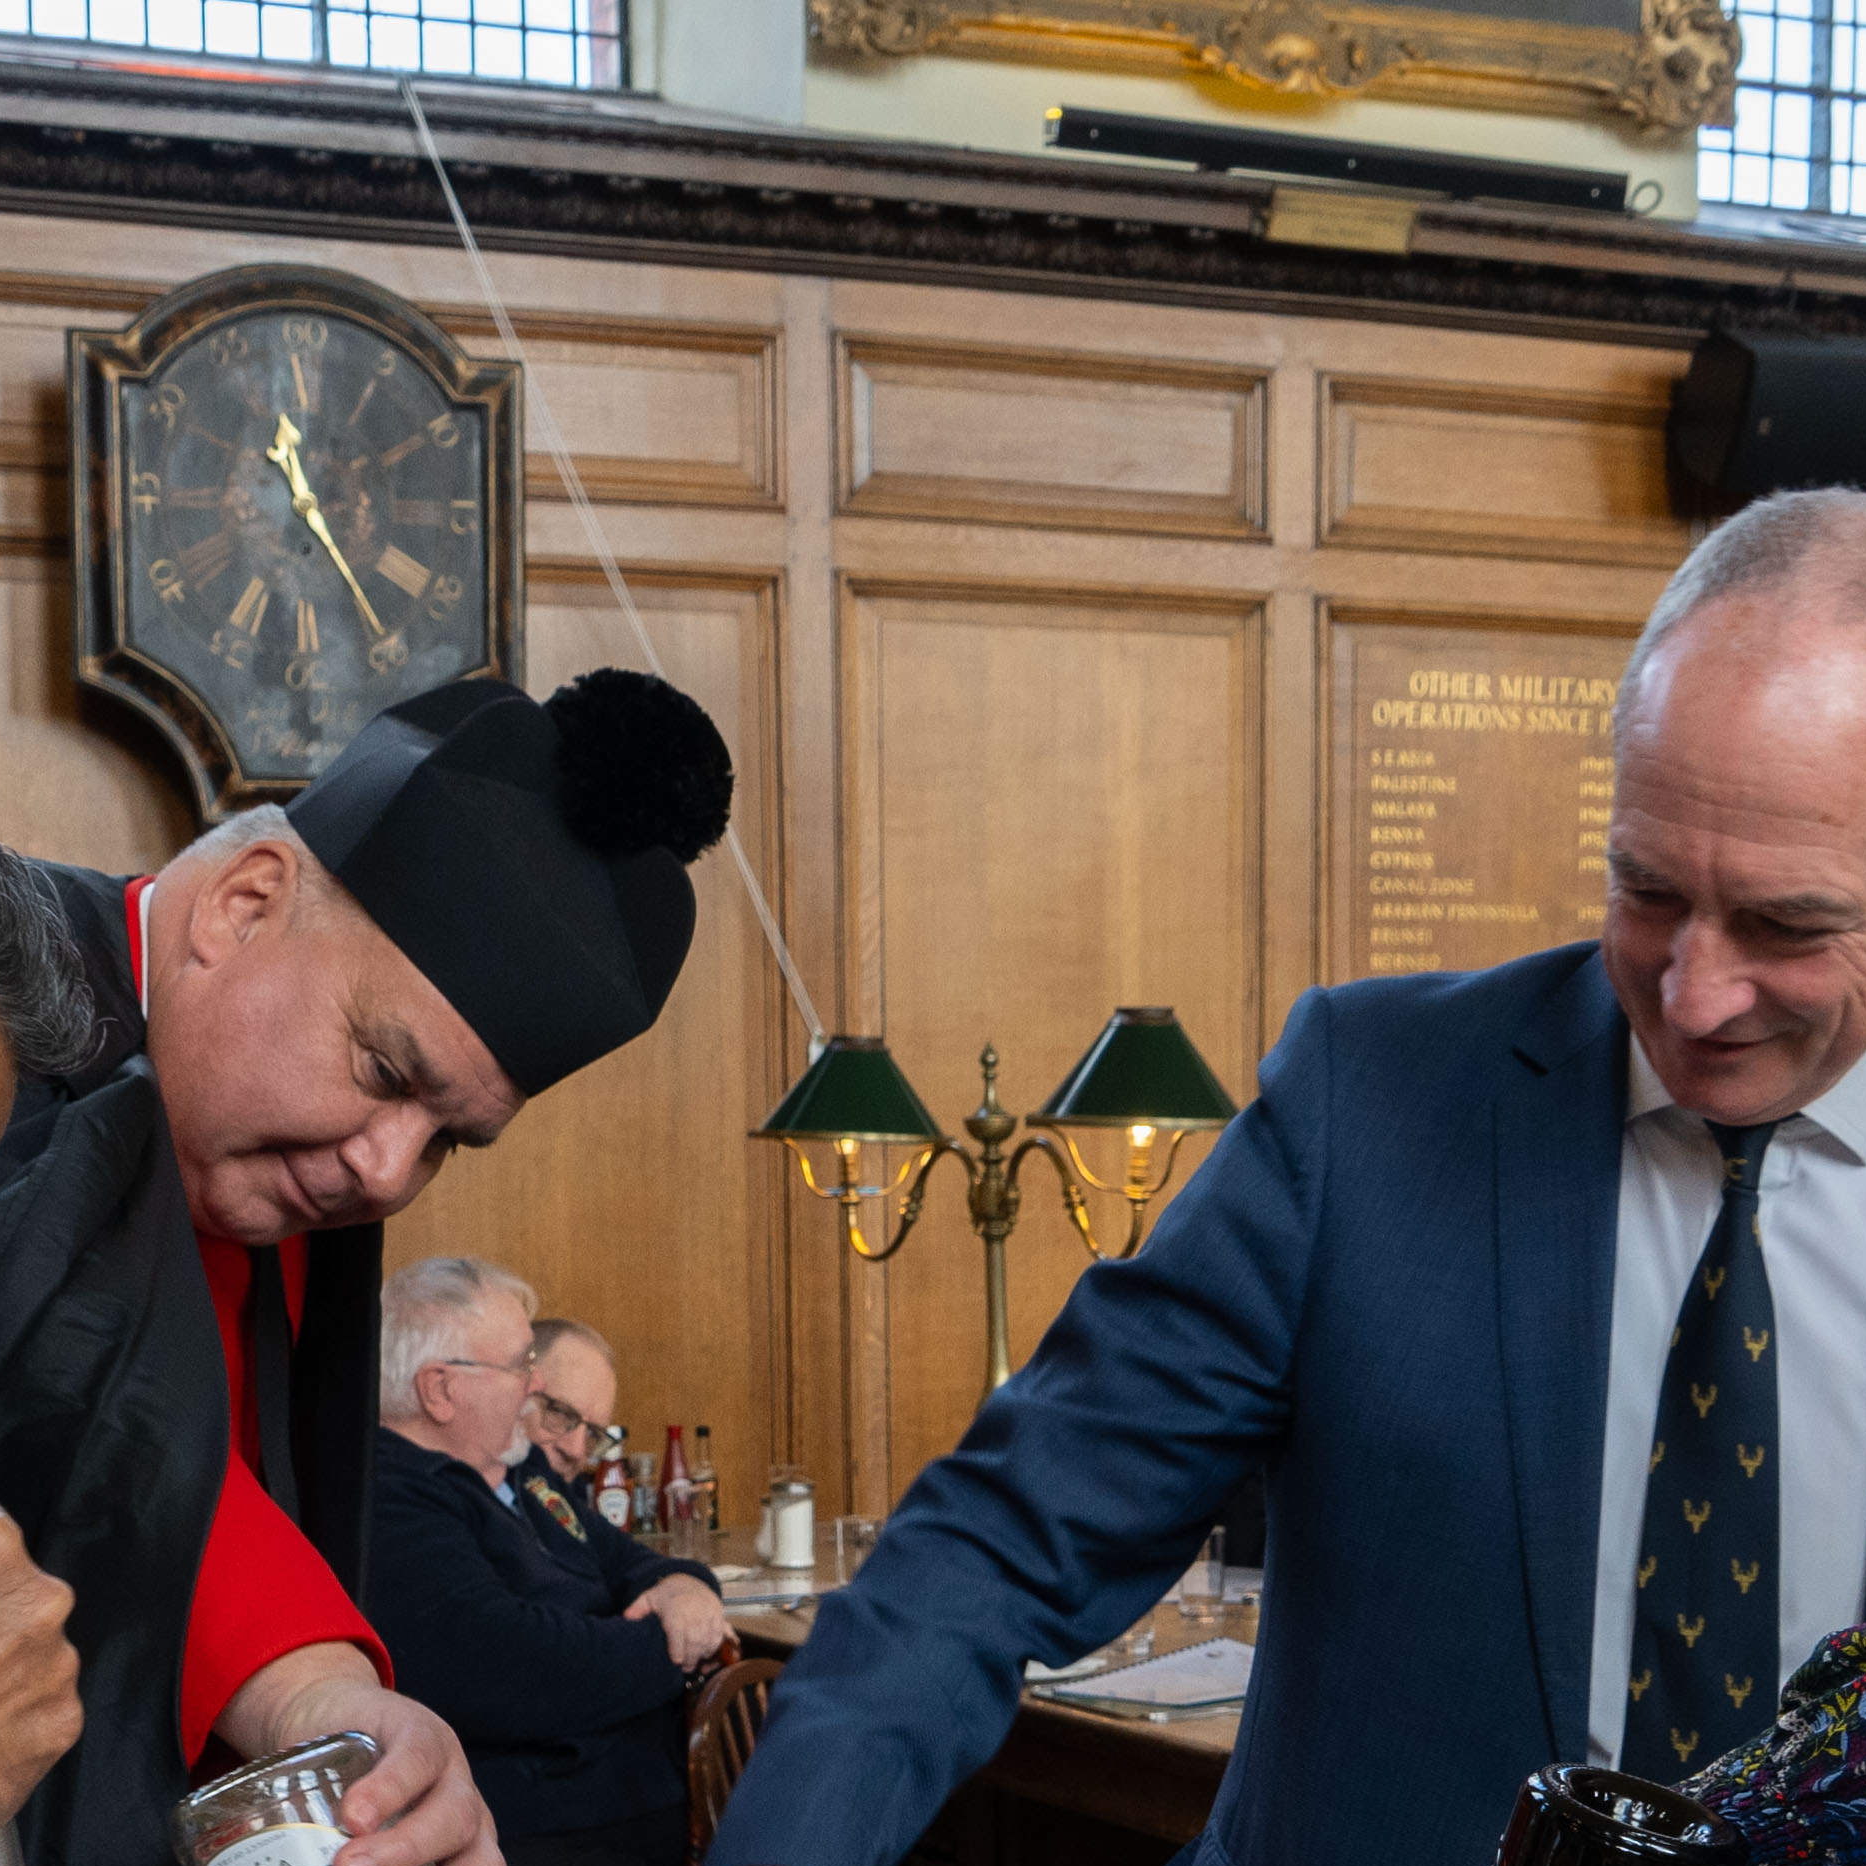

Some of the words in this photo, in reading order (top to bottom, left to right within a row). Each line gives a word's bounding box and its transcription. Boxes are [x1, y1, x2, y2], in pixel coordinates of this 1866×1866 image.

[283, 318, 329, 350] 60
[427, 411, 461, 449] 10
[1409, 669, 1492, 700] OTHER
[1499, 674, 1617, 707] MILITARY
[1371, 700, 1522, 733] OPERATIONS
[1526, 706, 1594, 736] SINCE
[1396, 749, 1435, 769] ASIA
[1370, 774, 1458, 794] PALESTINE
[1371, 800, 1437, 819] MALAYA
[1370, 825, 1425, 845] KENYA
[1369, 850, 1435, 871] CYPRUS
[1369, 875, 1425, 896] CANAL
[1428, 877, 1476, 896] ZONE
[1370, 902, 1444, 920] ARABIAN
[1447, 904, 1541, 923] PENINSULA
[1369, 927, 1434, 946] BRUNEI
[1369, 953, 1442, 971] BORNEO
